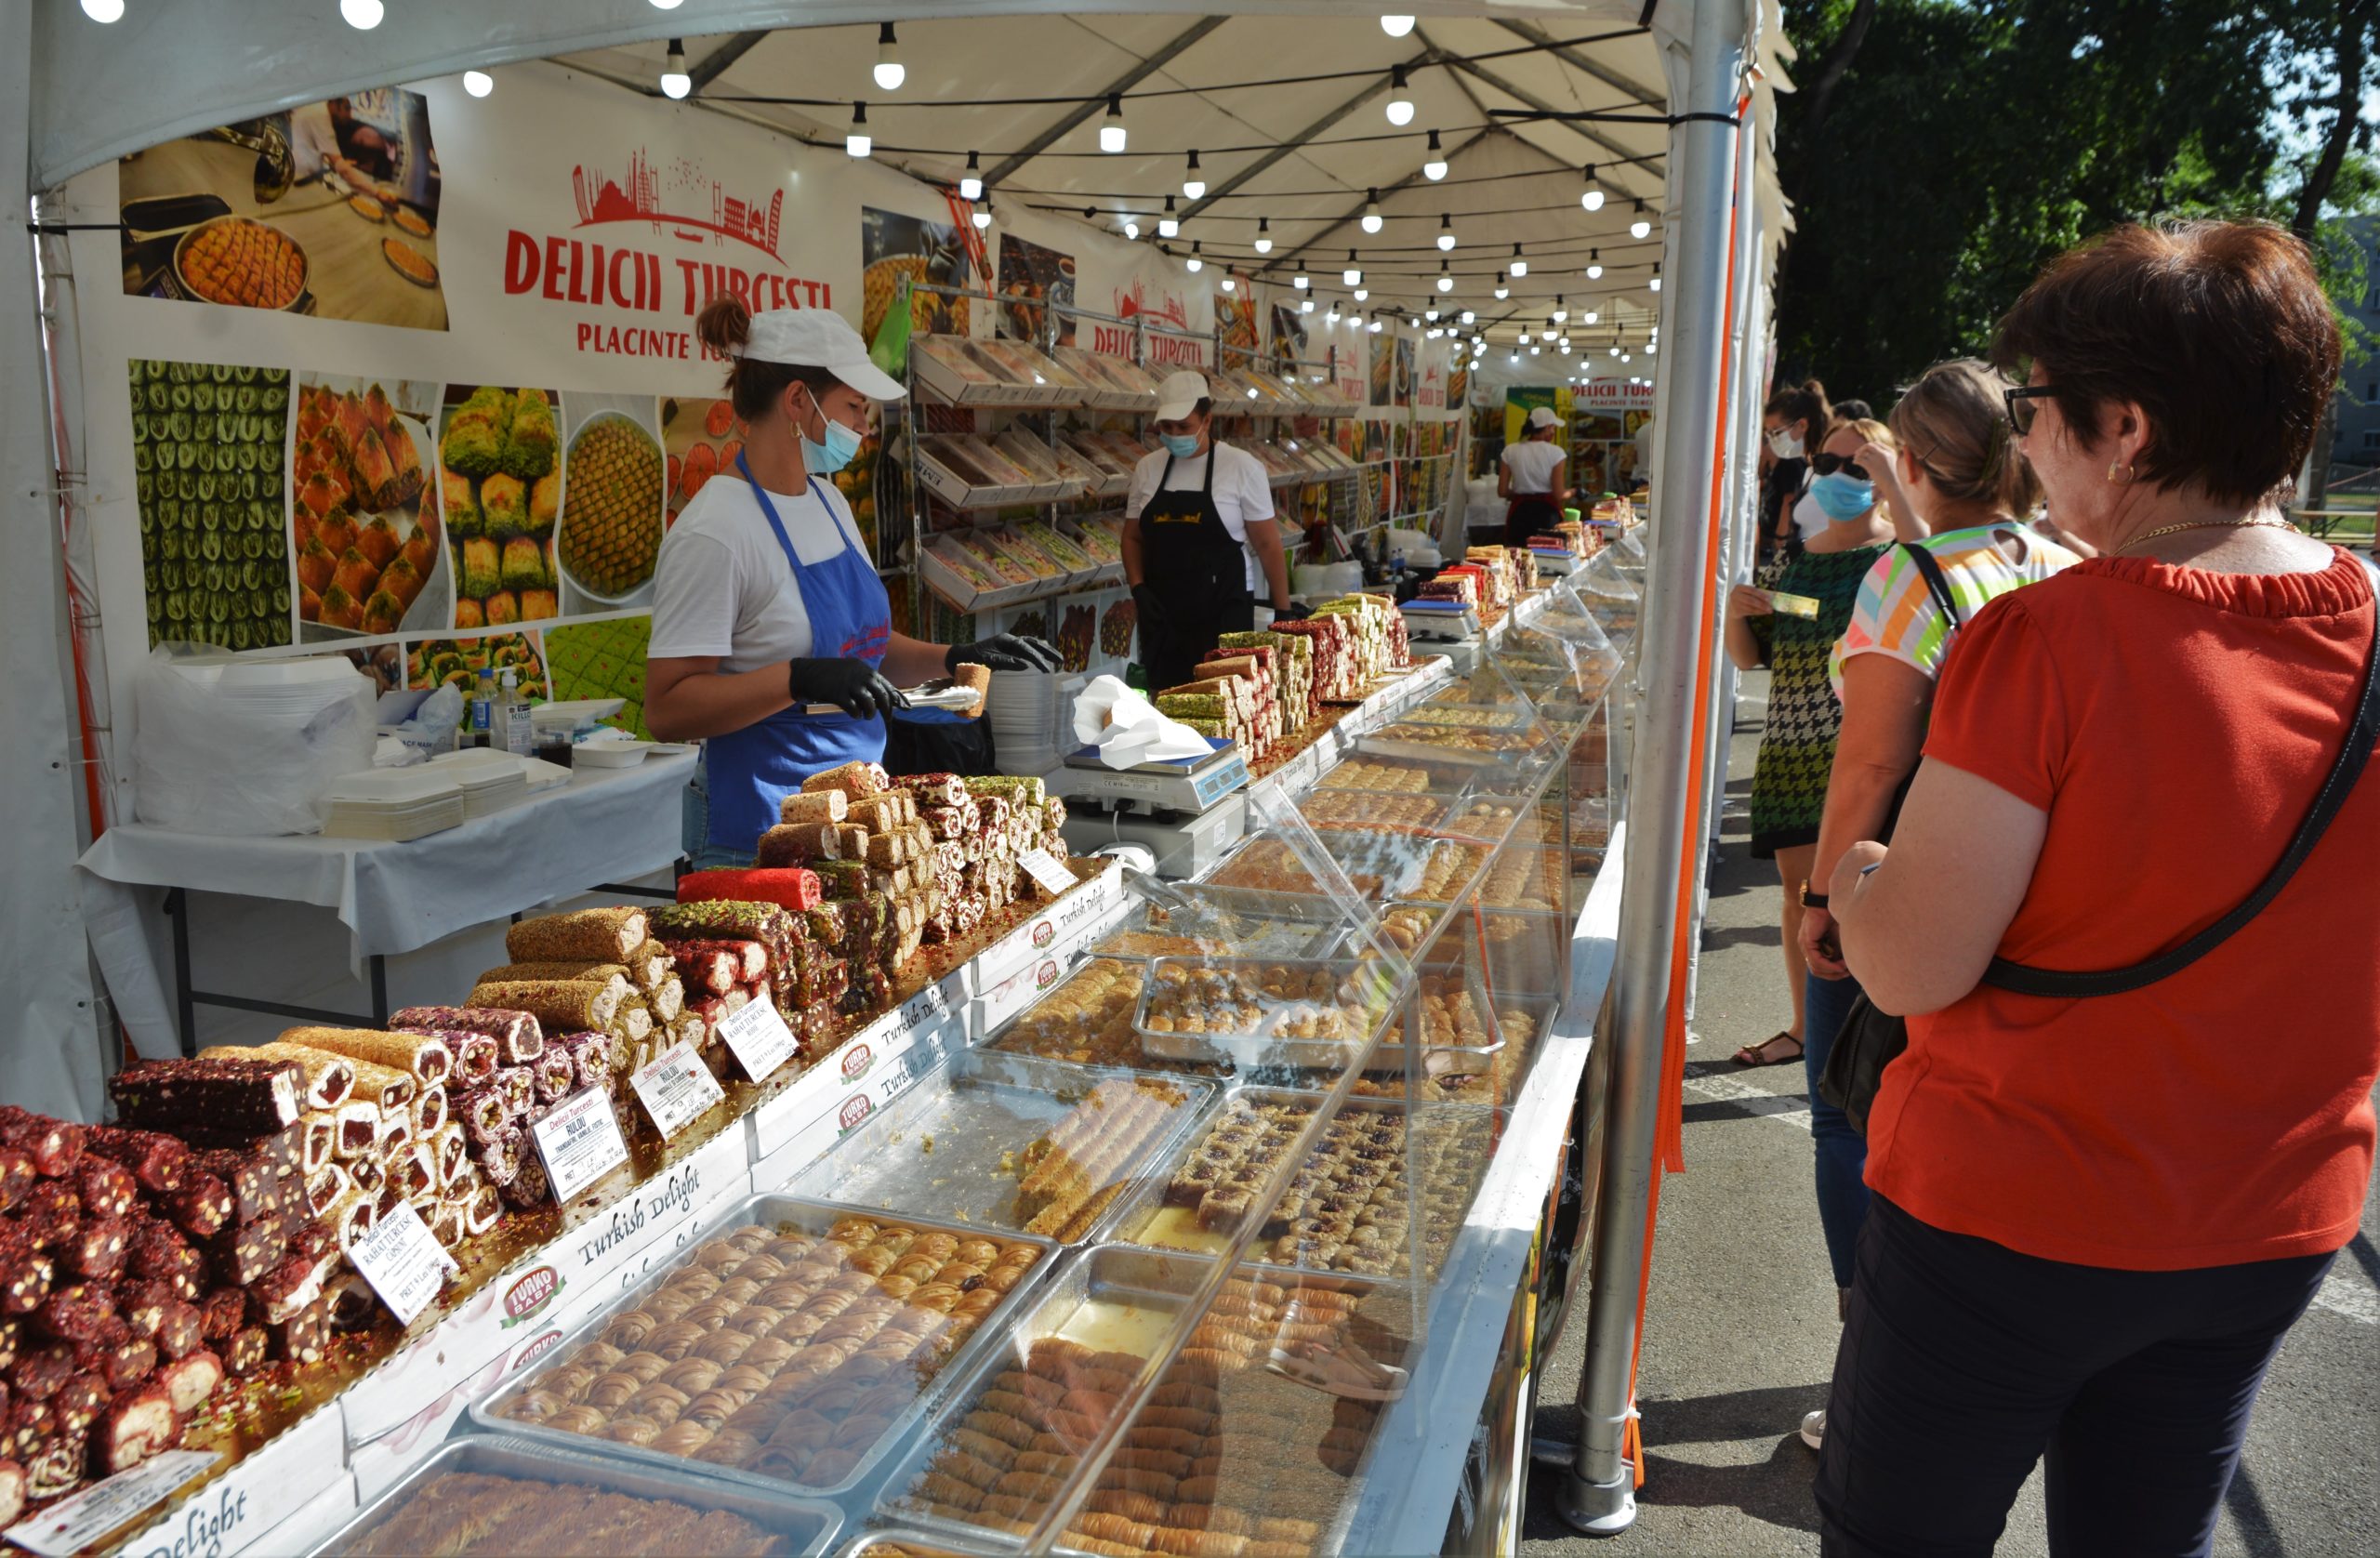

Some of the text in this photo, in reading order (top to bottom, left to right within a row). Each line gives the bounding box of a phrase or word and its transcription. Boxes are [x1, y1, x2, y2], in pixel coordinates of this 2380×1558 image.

[504, 230, 661, 311] DELICII
[577, 323, 690, 360] PLACINTE
[1570, 385, 1617, 397] DELICII
[1060, 884, 1105, 926] Turkish Delight
[881, 984, 949, 1045] Turkish Delight
[727, 1021, 747, 1039] RAHAT
[643, 1063, 661, 1080] Delicii
[844, 1047, 867, 1071] TURKO
[880, 1031, 946, 1097] Turkish Delight
[659, 1064, 680, 1084] RULOU
[549, 1110, 569, 1131] Delicii
[840, 1097, 866, 1122] TURKO
[845, 1106, 868, 1128] BABA
[565, 1116, 587, 1137] RULOU
[577, 1164, 700, 1266] Turkish Delight
[362, 1213, 413, 1266] RAHAT TURCESC
[363, 1226, 381, 1247] Delicii
[508, 1270, 551, 1307] TURKO
[513, 1284, 554, 1315] BABA
